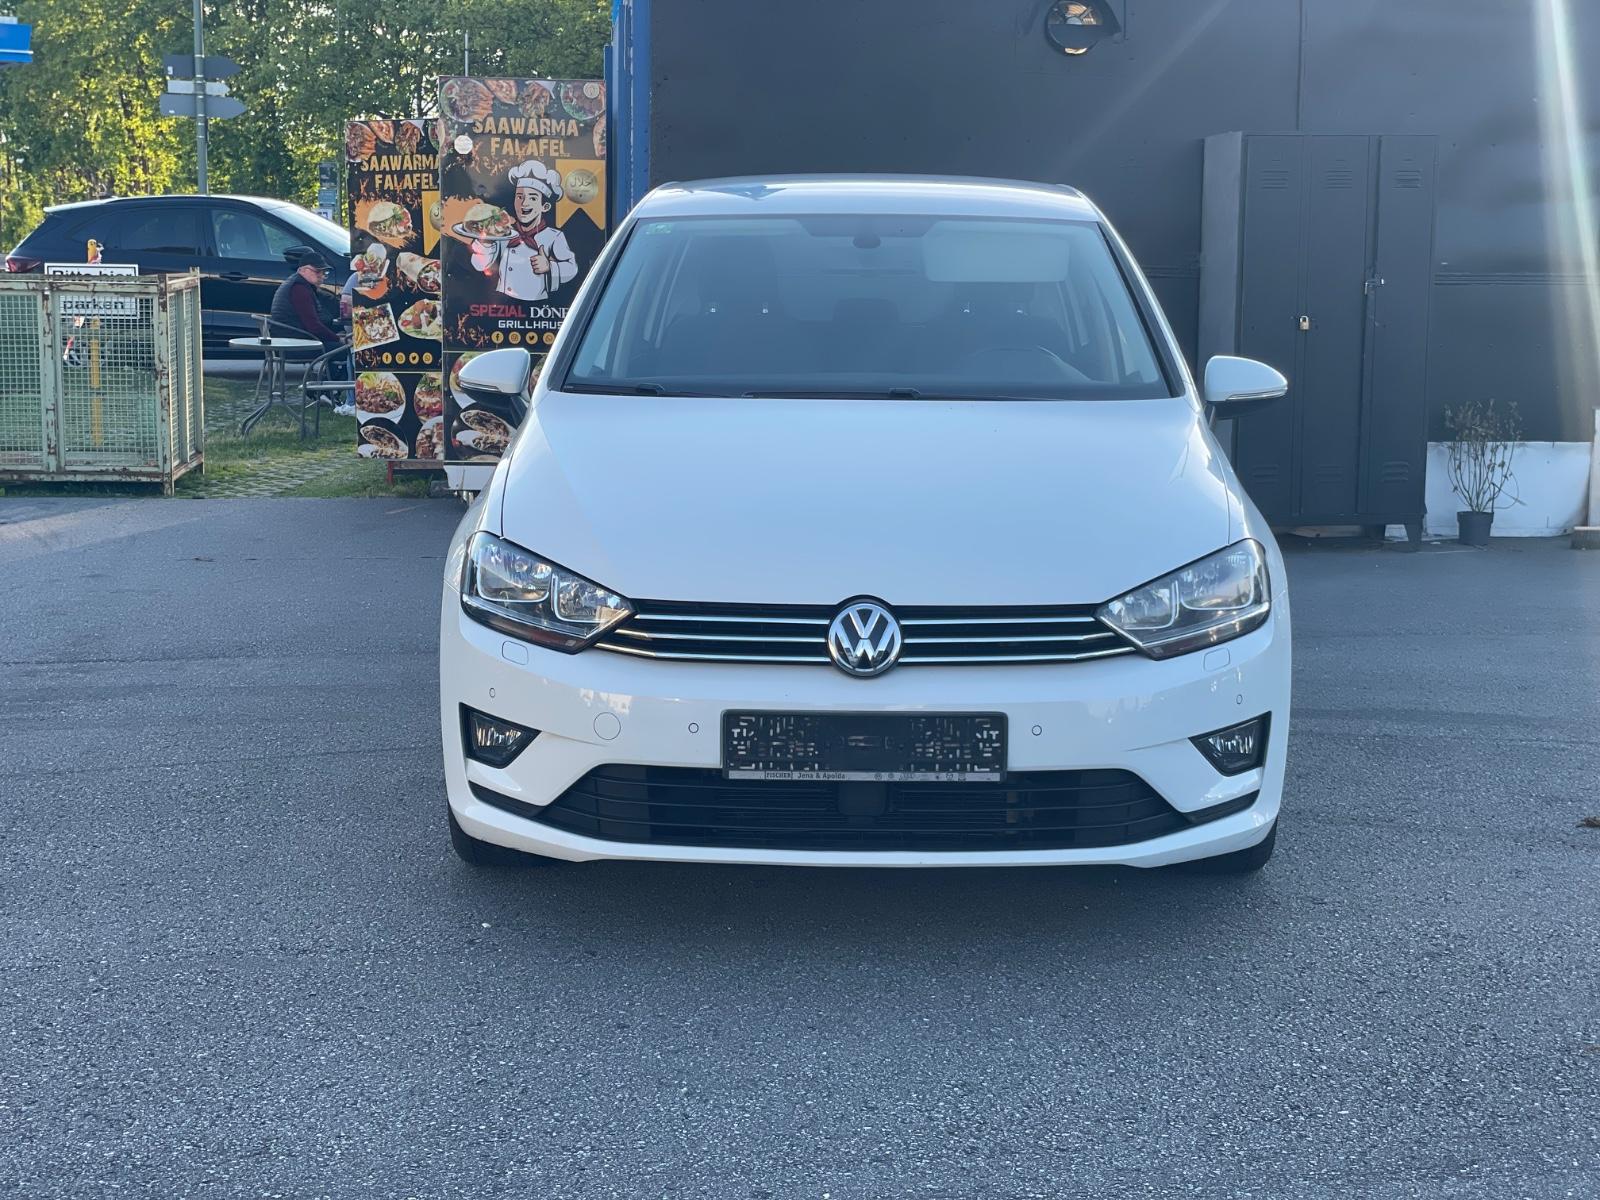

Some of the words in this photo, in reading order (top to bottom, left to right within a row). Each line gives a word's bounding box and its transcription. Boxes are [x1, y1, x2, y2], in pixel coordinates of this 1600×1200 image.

[472, 116, 579, 137] SAAWARMA
[490, 137, 571, 157] FALAFEL
[375, 172, 438, 190] FALAFEL
[63, 298, 125, 312] parken
[469, 304, 526, 318] SPEZIAL
[797, 771, 813, 779] Jena
